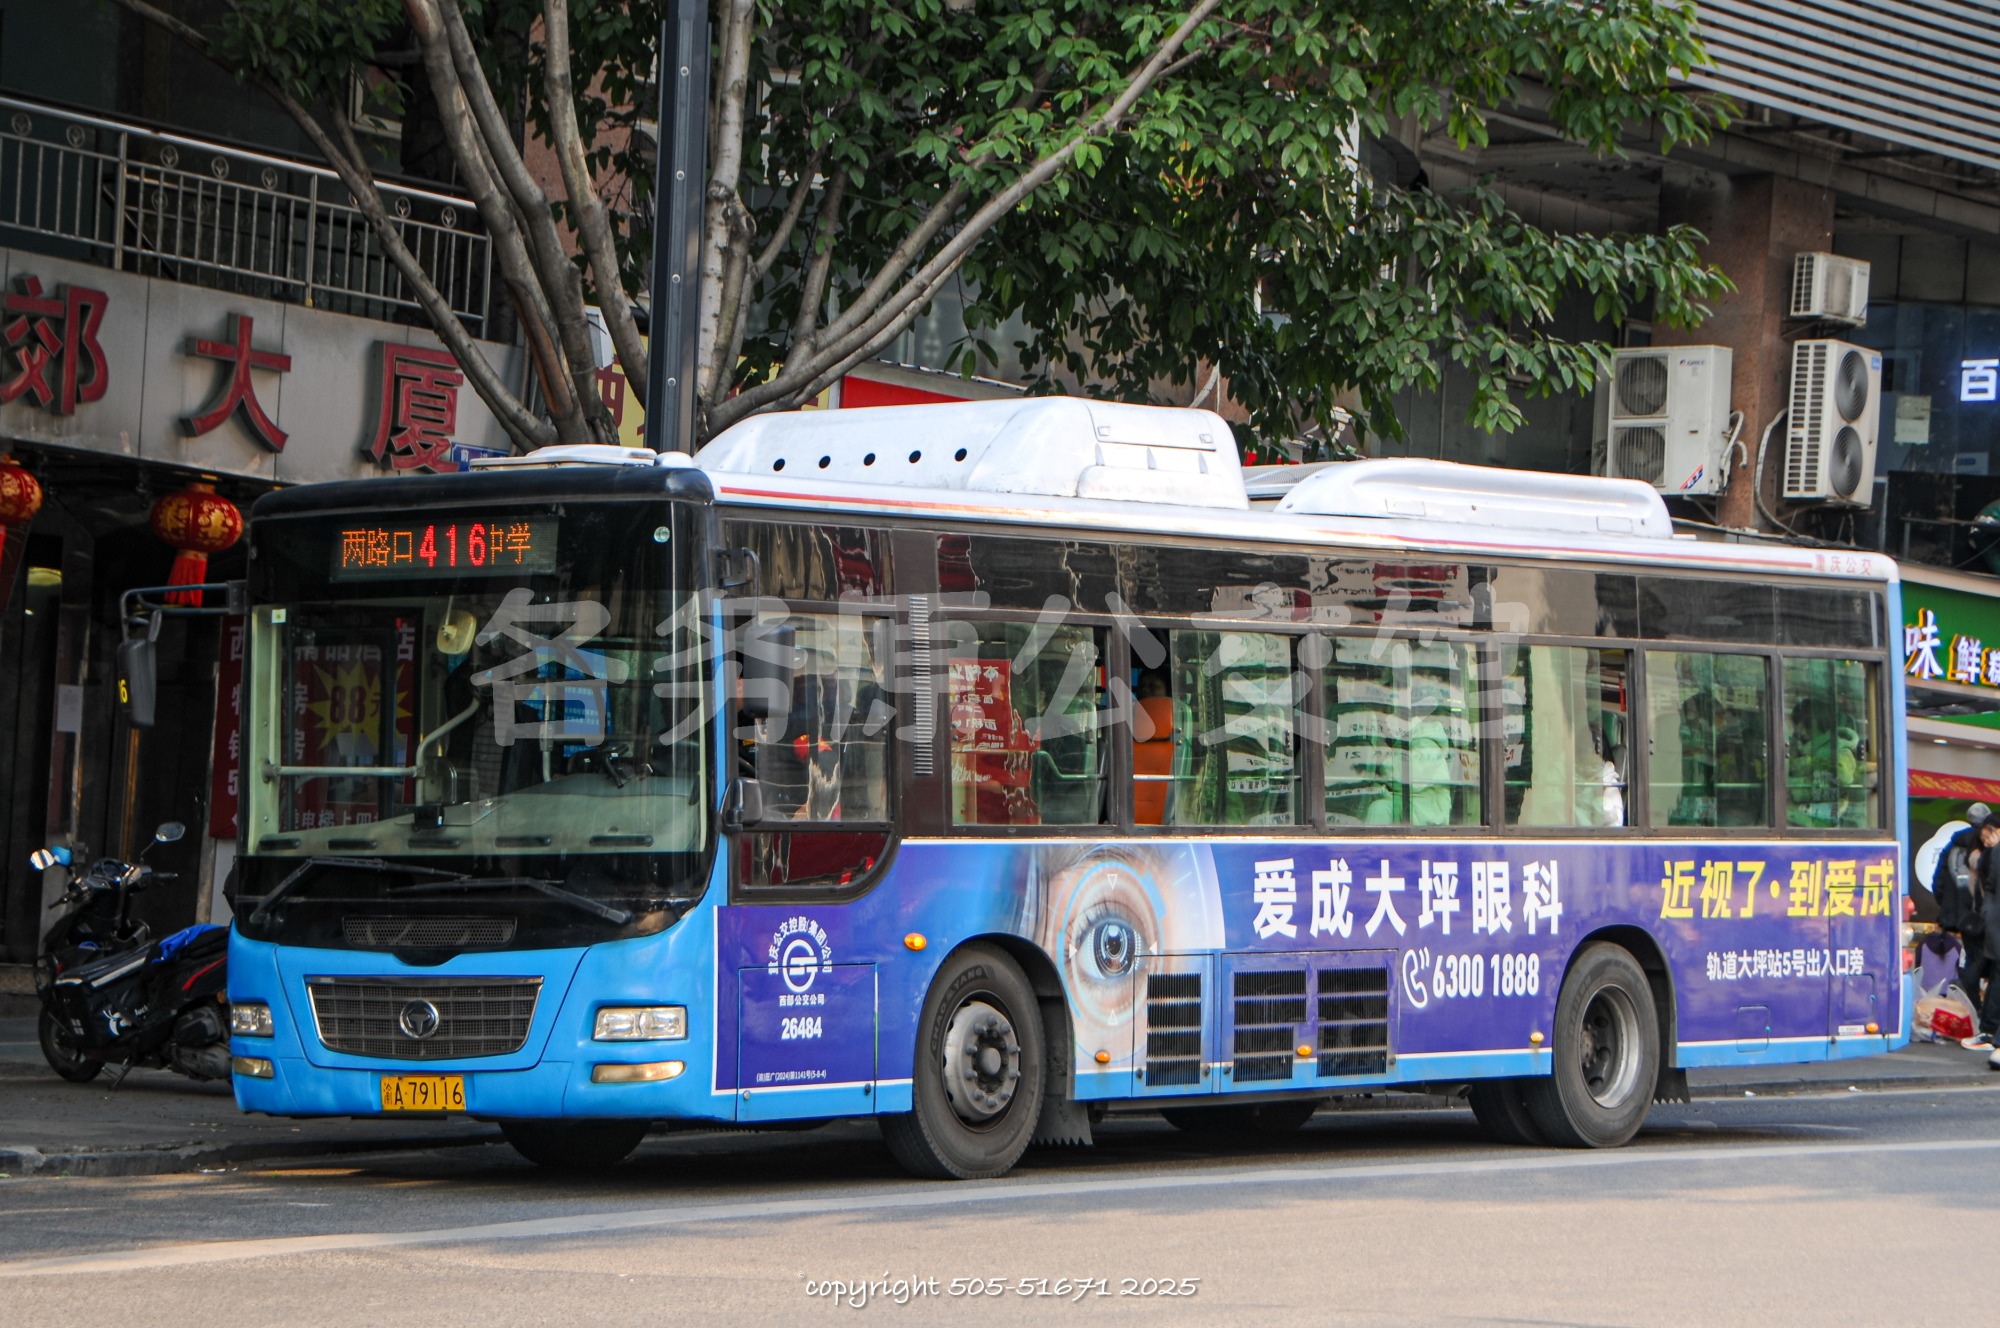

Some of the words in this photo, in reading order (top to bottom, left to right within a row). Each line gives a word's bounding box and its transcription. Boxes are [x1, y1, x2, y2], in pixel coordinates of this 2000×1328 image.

[1960, 359, 1999, 401] 百
[342, 528, 412, 567] 两路口
[419, 523, 486, 567] 416
[1815, 554, 1872, 576] 重庆公交
[1253, 857, 1563, 940] 爱成大坪眼科
[1432, 953, 1484, 998] 6300
[1490, 952, 1540, 996] 1888
[1706, 947, 1864, 981] 轨道大坪站5号出入口旁
[779, 993, 825, 1007] 西部公交公司
[781, 1016, 823, 1040] 26484
